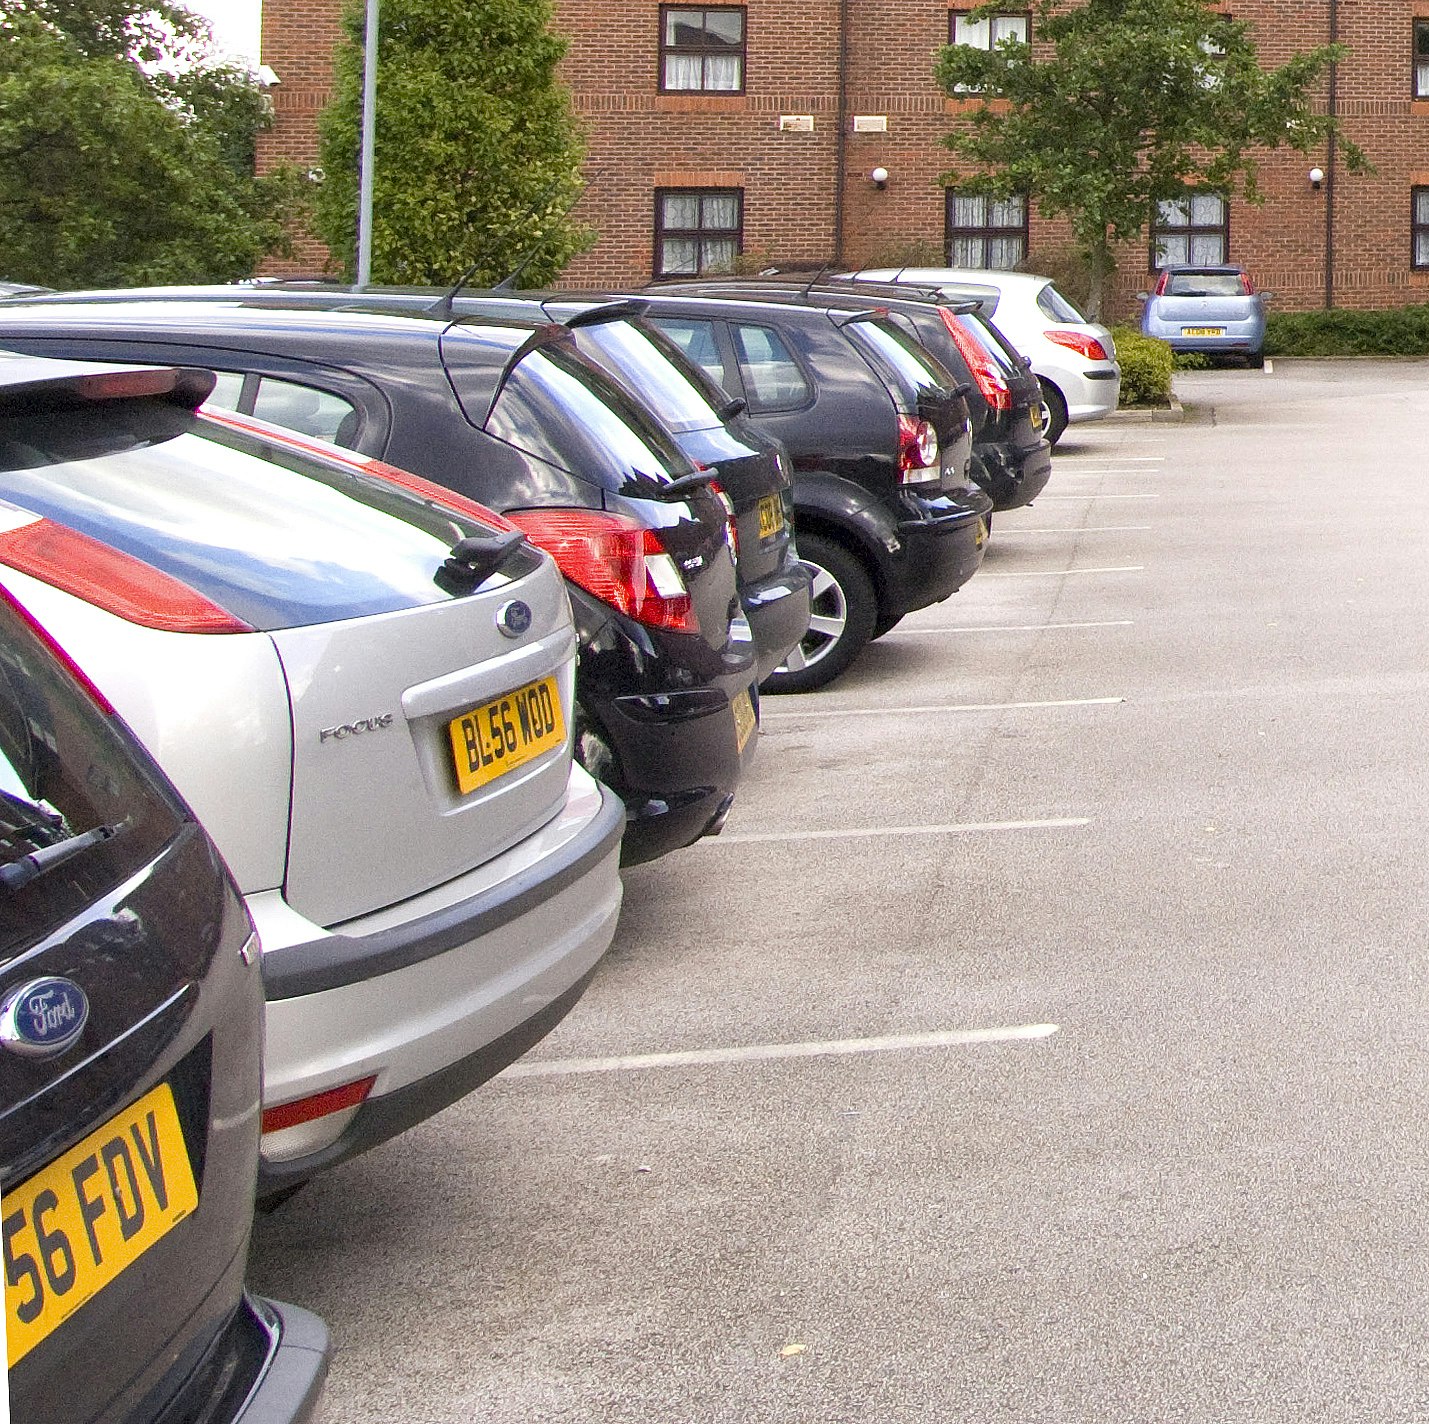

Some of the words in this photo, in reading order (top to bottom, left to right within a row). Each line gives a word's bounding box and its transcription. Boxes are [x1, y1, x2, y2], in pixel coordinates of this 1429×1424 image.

[319, 713, 394, 743] FOCUS
[461, 701, 518, 773] BL56
[515, 684, 555, 746] WOD
[29, 989, 76, 1036] Ford
[3, 1188, 77, 1324] 56
[71, 1110, 168, 1267] FDV
